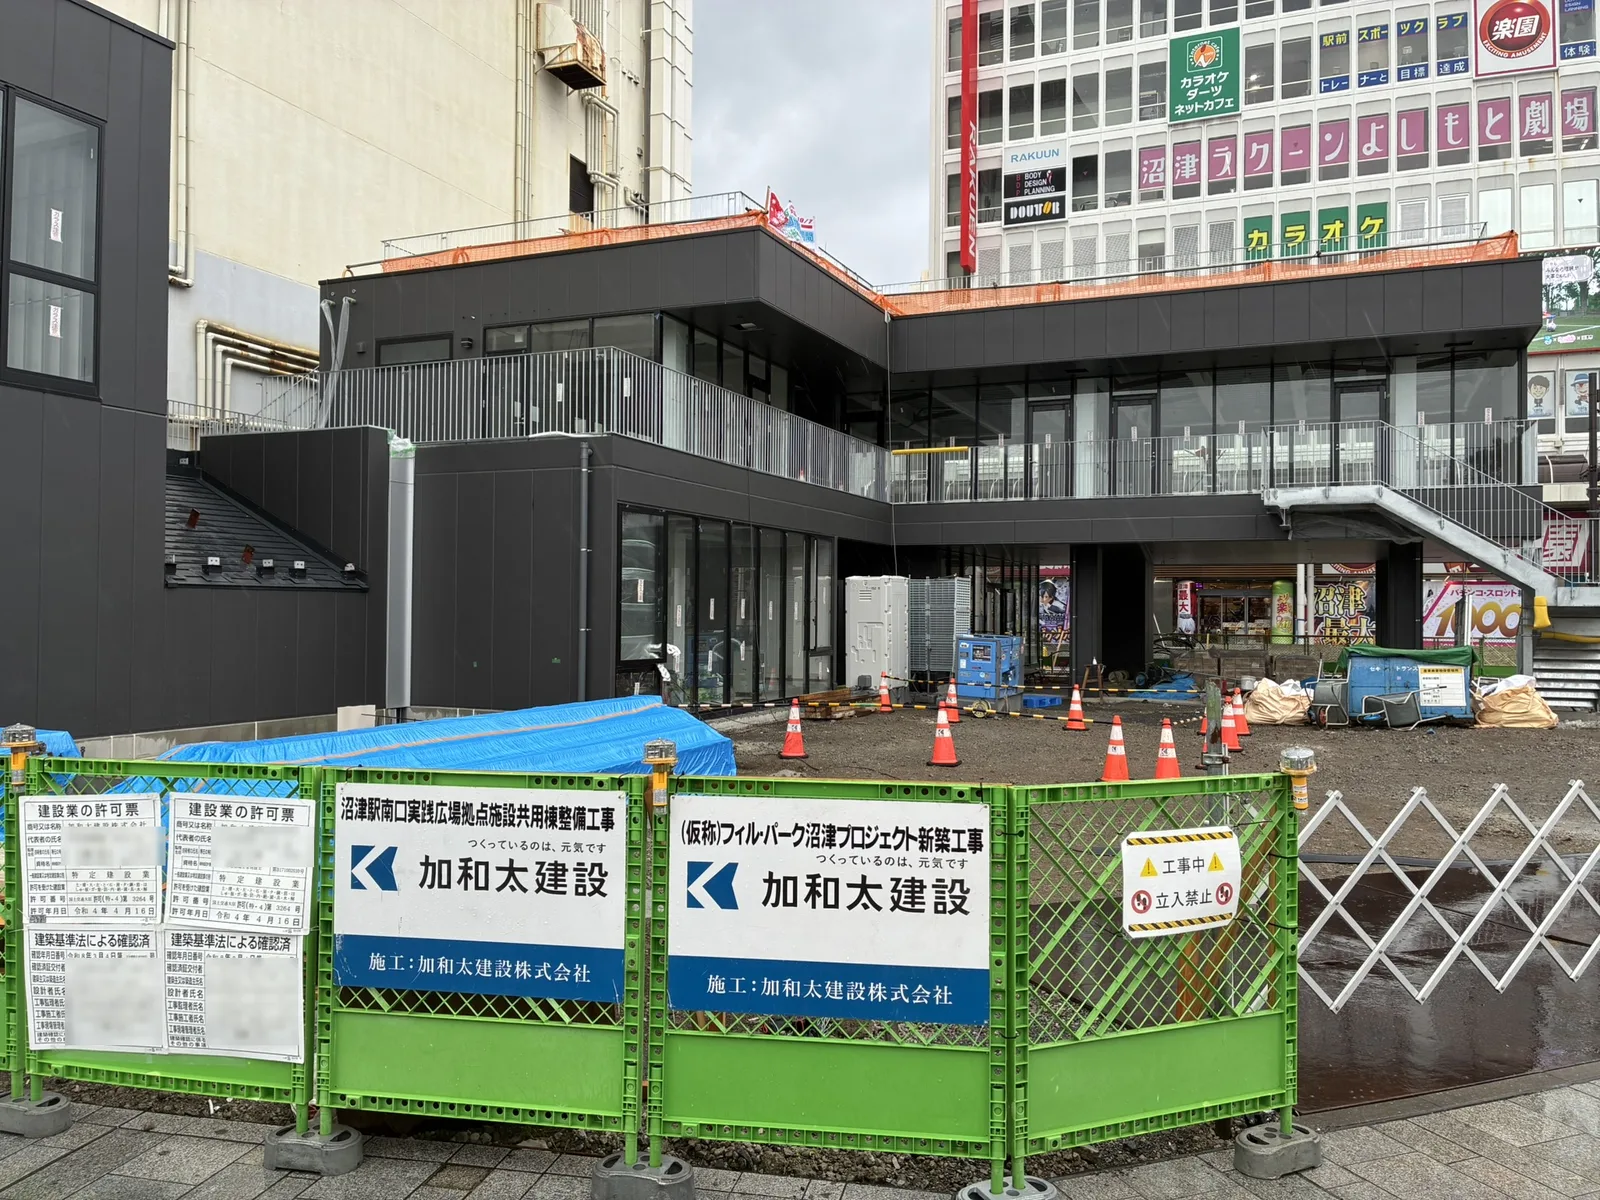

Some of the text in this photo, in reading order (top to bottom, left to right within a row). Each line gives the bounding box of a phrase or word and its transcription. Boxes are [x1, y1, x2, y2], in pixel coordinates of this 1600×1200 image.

[1491, 14, 1540, 41] 楽園
[1483, 32, 1547, 58] EXCITING AMUSEMENT
[1564, 45, 1590, 58] 体験
[1181, 70, 1229, 89] カラオケ
[1186, 84, 1222, 99] ダーツ
[1174, 97, 1234, 116] ネットカフェ
[1010, 149, 1059, 163] RAKUUN
[1024, 171, 1042, 180] BODY
[1024, 178, 1047, 188] DESIGN
[1024, 185, 1056, 196] PLANNING
[1248, 216, 1384, 251] カラオケ
[38, 803, 140, 818] 建設業の許可票
[189, 802, 295, 822] 建設業の許可票
[340, 797, 616, 832] 沼津駅南口実践広場拠点施設共用棟整備工事
[467, 838, 607, 854] つくっているのは、元気です
[815, 854, 969, 870] つくっているのは、元気です
[1162, 856, 1205, 875] 工事中
[418, 855, 609, 898] 加和太建設
[761, 870, 971, 916] 加和太建設
[1155, 889, 1212, 910] 立入禁止
[35, 933, 150, 949] 建築基準法による確認済
[171, 933, 291, 952] 建築基準法による確認済
[167, 987, 203, 999] 設計者氏名
